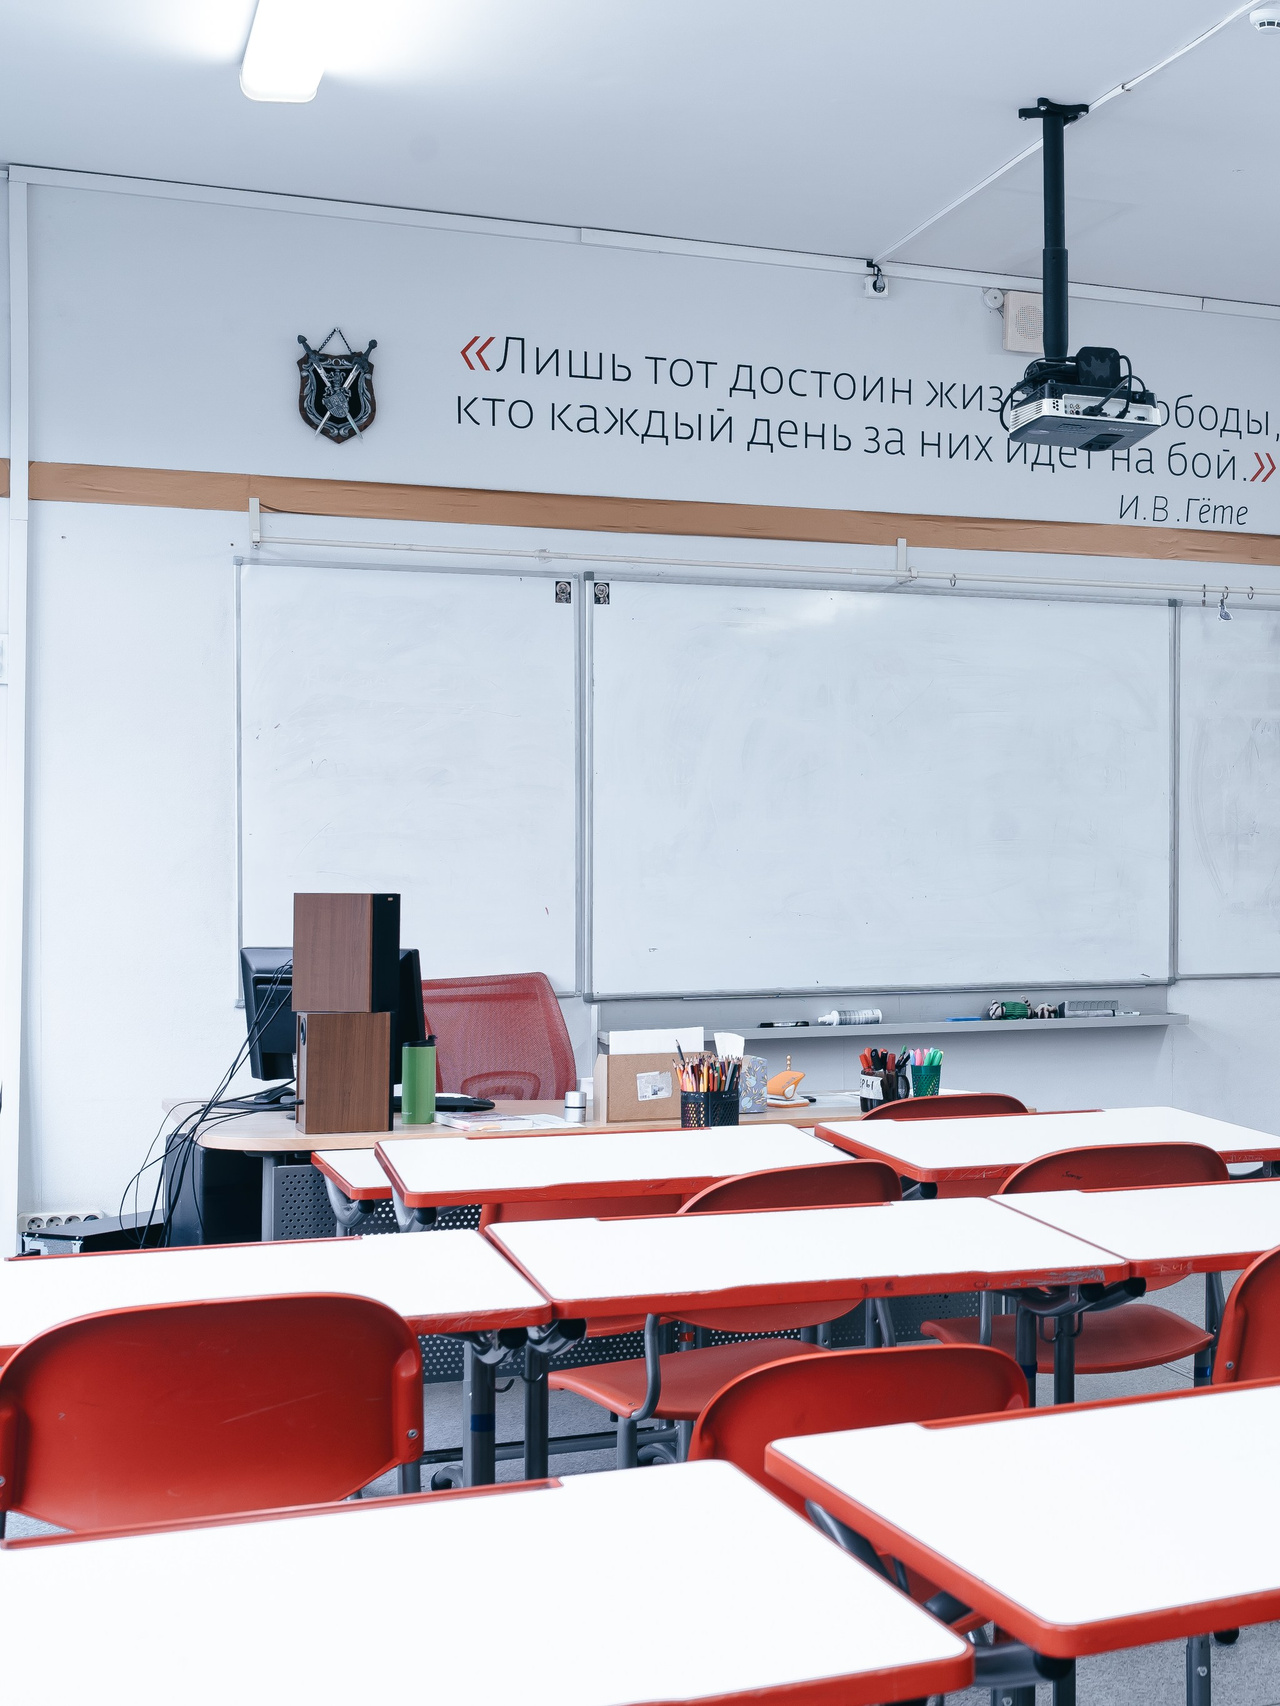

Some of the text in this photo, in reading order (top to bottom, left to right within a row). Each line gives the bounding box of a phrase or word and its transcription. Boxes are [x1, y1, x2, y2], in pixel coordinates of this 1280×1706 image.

[460, 335, 1280, 442] «Лишь тот достоин жиз ободы,
[457, 395, 534, 429] кто
[551, 402, 733, 446] каждый
[747, 417, 852, 454] день
[863, 426, 905, 456] за
[921, 430, 993, 462] них
[1111, 447, 1154, 475] на
[1167, 442, 1277, 483] бой.»
